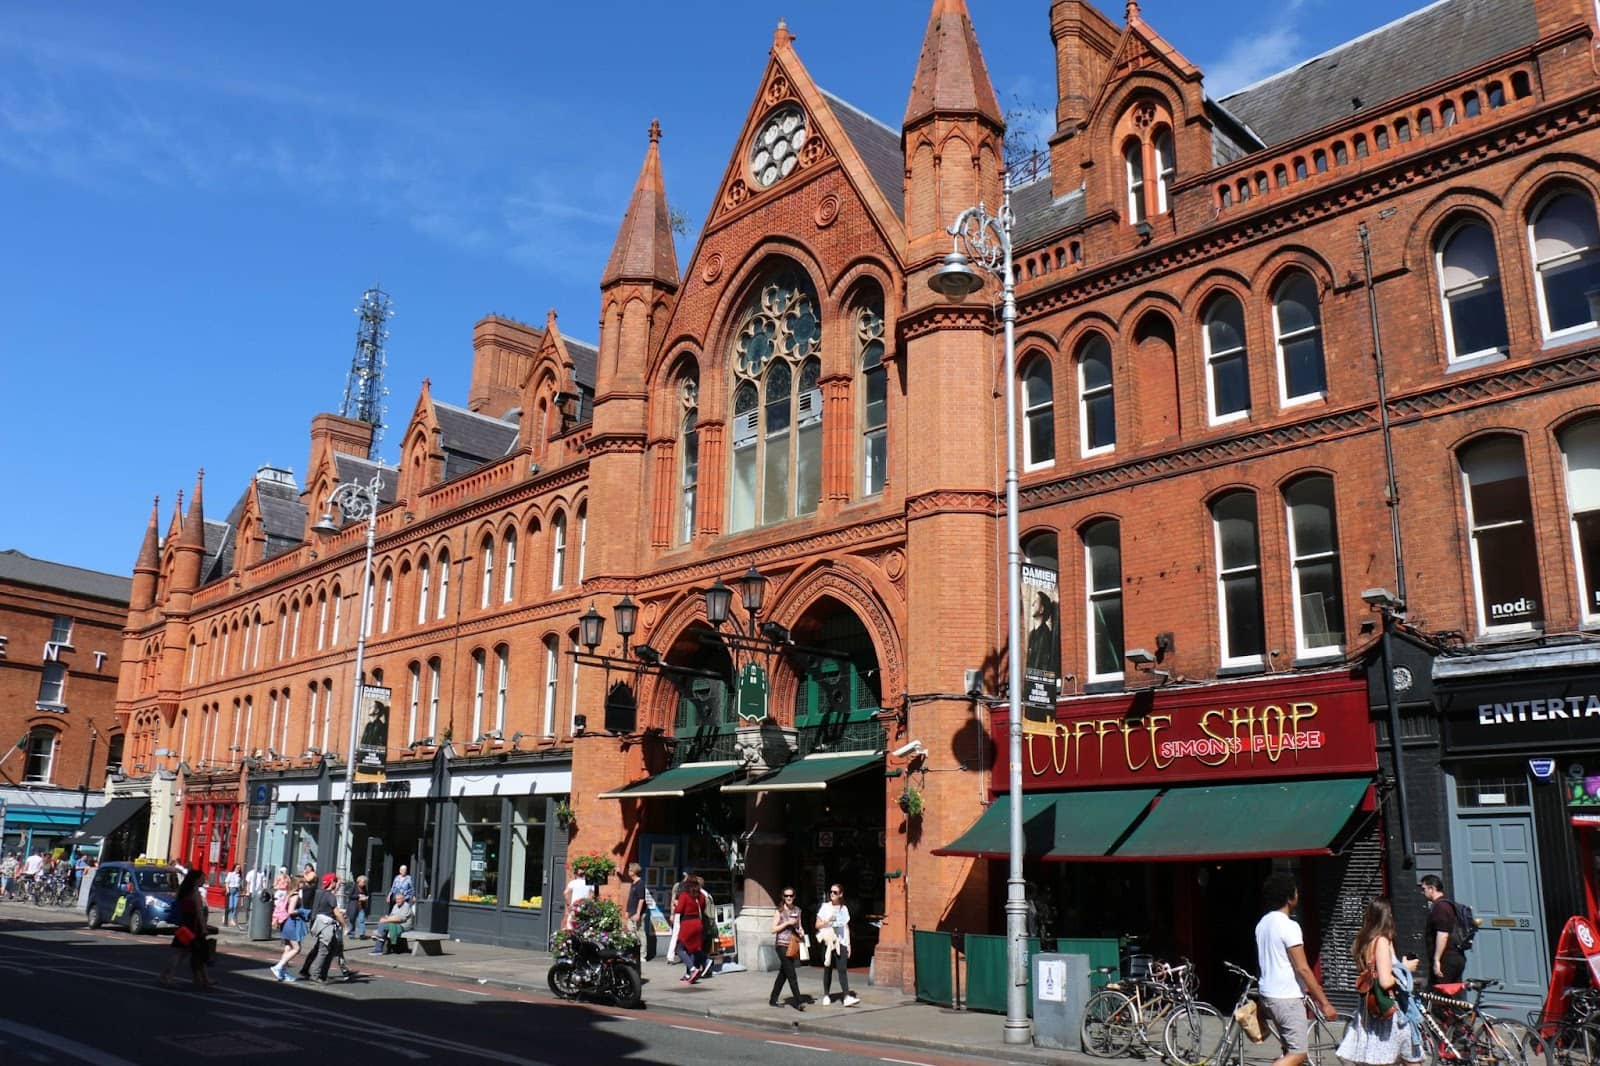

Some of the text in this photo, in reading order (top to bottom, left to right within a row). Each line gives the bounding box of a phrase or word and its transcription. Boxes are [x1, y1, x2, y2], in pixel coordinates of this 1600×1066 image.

[1022, 566, 1057, 582] DAMIEN
[1491, 598, 1536, 614] noda
[1198, 702, 1318, 767] SHOP
[1161, 730, 1321, 759] SIMON'S PLACE
[1520, 919, 1530, 928] 23
